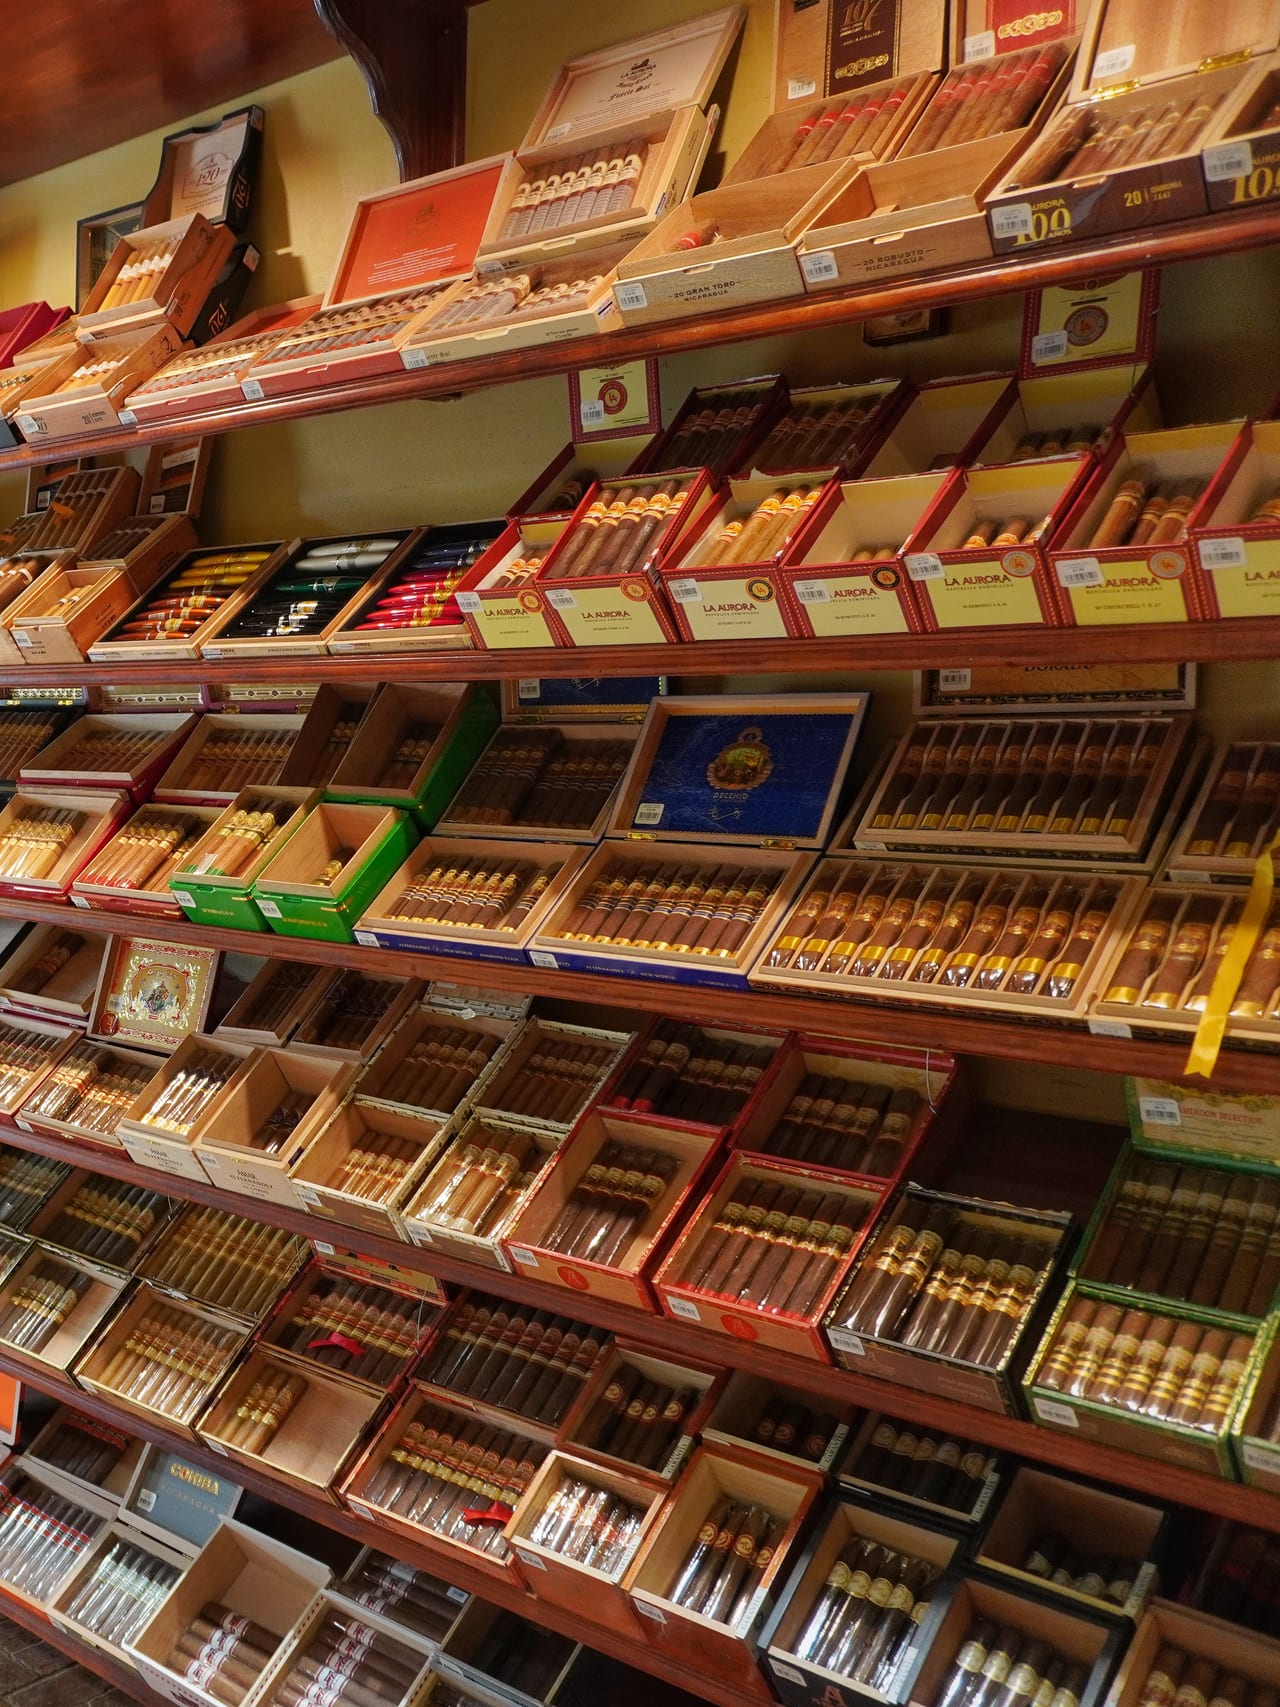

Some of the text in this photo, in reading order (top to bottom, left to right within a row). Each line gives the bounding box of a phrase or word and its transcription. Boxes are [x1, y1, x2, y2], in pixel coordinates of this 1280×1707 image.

[1124, 190, 1142, 208] 20
[877, 250, 924, 264] ROBUSTO
[865, 256, 924, 272] NICARAGUA
[686, 287, 711, 297] GRAN
[712, 280, 736, 291] TORO
[684, 289, 730, 302] NICARAGUA
[944, 574, 1012, 587] LA AURORA
[1104, 577, 1160, 589] AURORA
[834, 587, 877, 598] AURORA
[484, 608, 528, 617] LA AURORA
[703, 602, 758, 613] LA AURORA
[581, 610, 631, 620] LA AURORA
[170, 1462, 219, 1496] COHIBA
